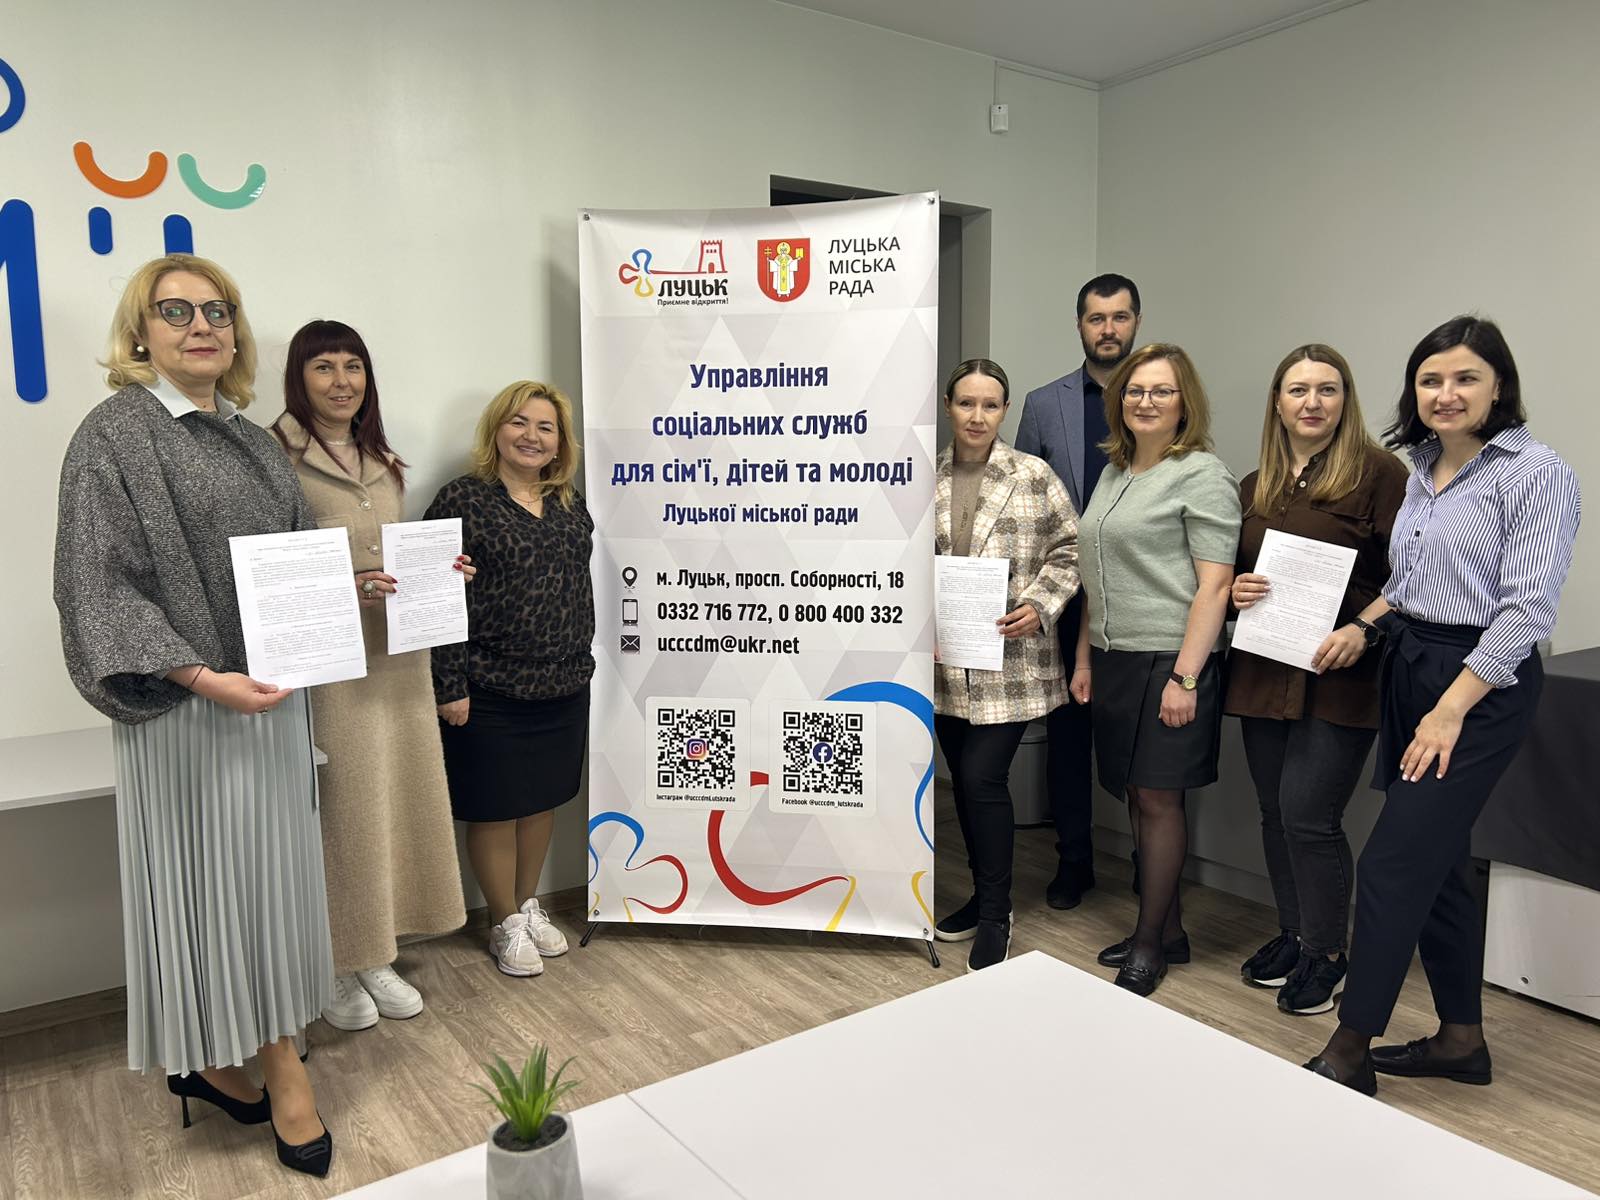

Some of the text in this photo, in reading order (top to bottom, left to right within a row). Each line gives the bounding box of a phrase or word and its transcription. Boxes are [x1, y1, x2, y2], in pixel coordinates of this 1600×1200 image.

[828, 236, 901, 256] ЛУЦЬКА
[829, 257, 896, 275] МІСЬКА
[829, 279, 875, 298] РАДА
[691, 298, 729, 306] відкриття!
[690, 362, 828, 392] Управління
[652, 410, 868, 439] соціальних служб
[612, 457, 913, 487] для сім'ї, дітей та молоді
[662, 504, 858, 526] Луцької міської ради
[657, 569, 904, 591] м. Луцьк, просп. Соборності, 18
[657, 602, 903, 625] 0332 716 772, 0 800 400 332
[657, 634, 800, 655] ucccdm@ukr.net
[781, 798, 808, 806] Facebook
